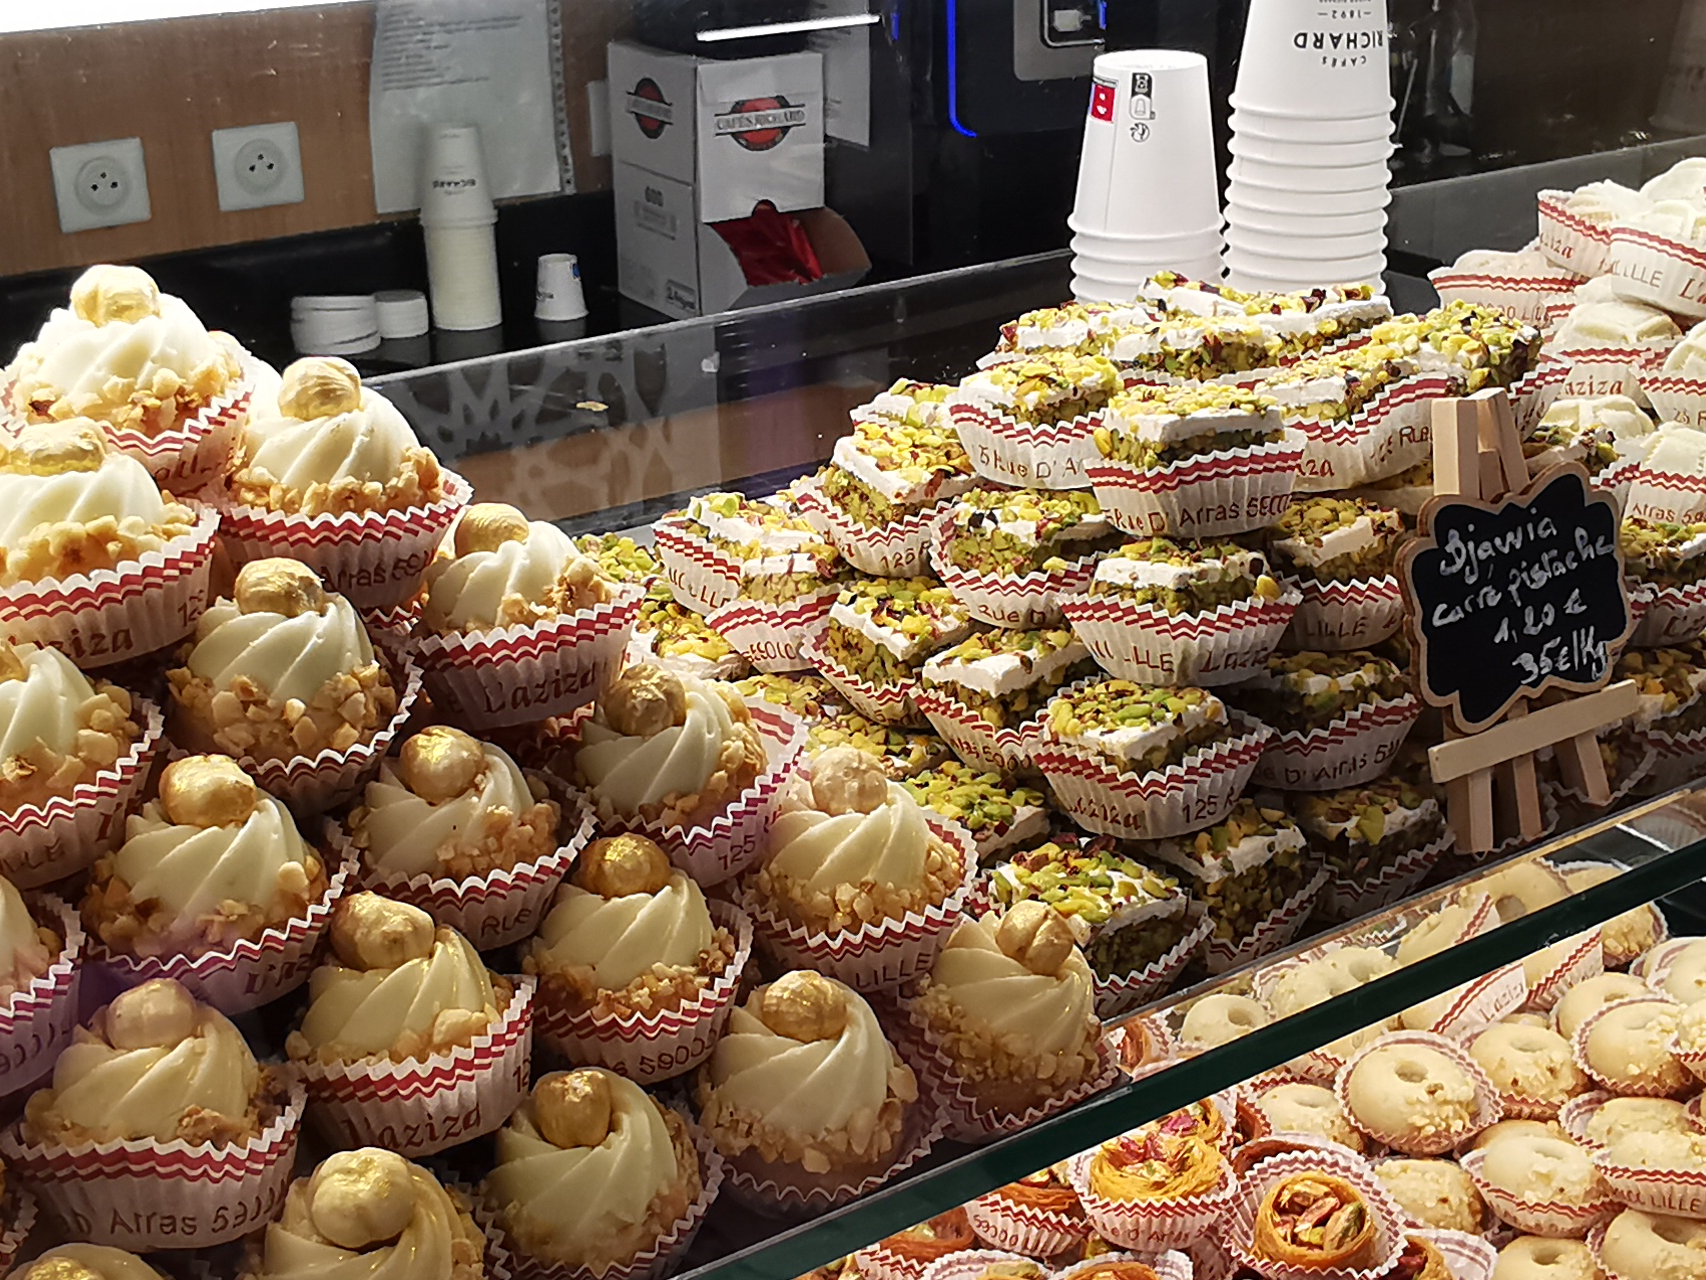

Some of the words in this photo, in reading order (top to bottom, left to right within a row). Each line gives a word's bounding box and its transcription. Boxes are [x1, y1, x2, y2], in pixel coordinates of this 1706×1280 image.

[1293, 30, 1384, 50] RICHARD
[1322, 55, 1367, 68] CAFÉS
[1178, 502, 1240, 529] Arras
[879, 551, 916, 568] 125
[1507, 526, 1616, 608] pistache
[320, 559, 387, 591] Arras
[977, 603, 1020, 623] Rue
[483, 668, 598, 715] L'aziza
[1182, 795, 1218, 823] 125
[717, 838, 757, 873] 125
[480, 908, 532, 938] Rue
[853, 951, 931, 988] LILLE
[1655, 1193, 1701, 1213] LILLE
[109, 1207, 198, 1237] Arras
